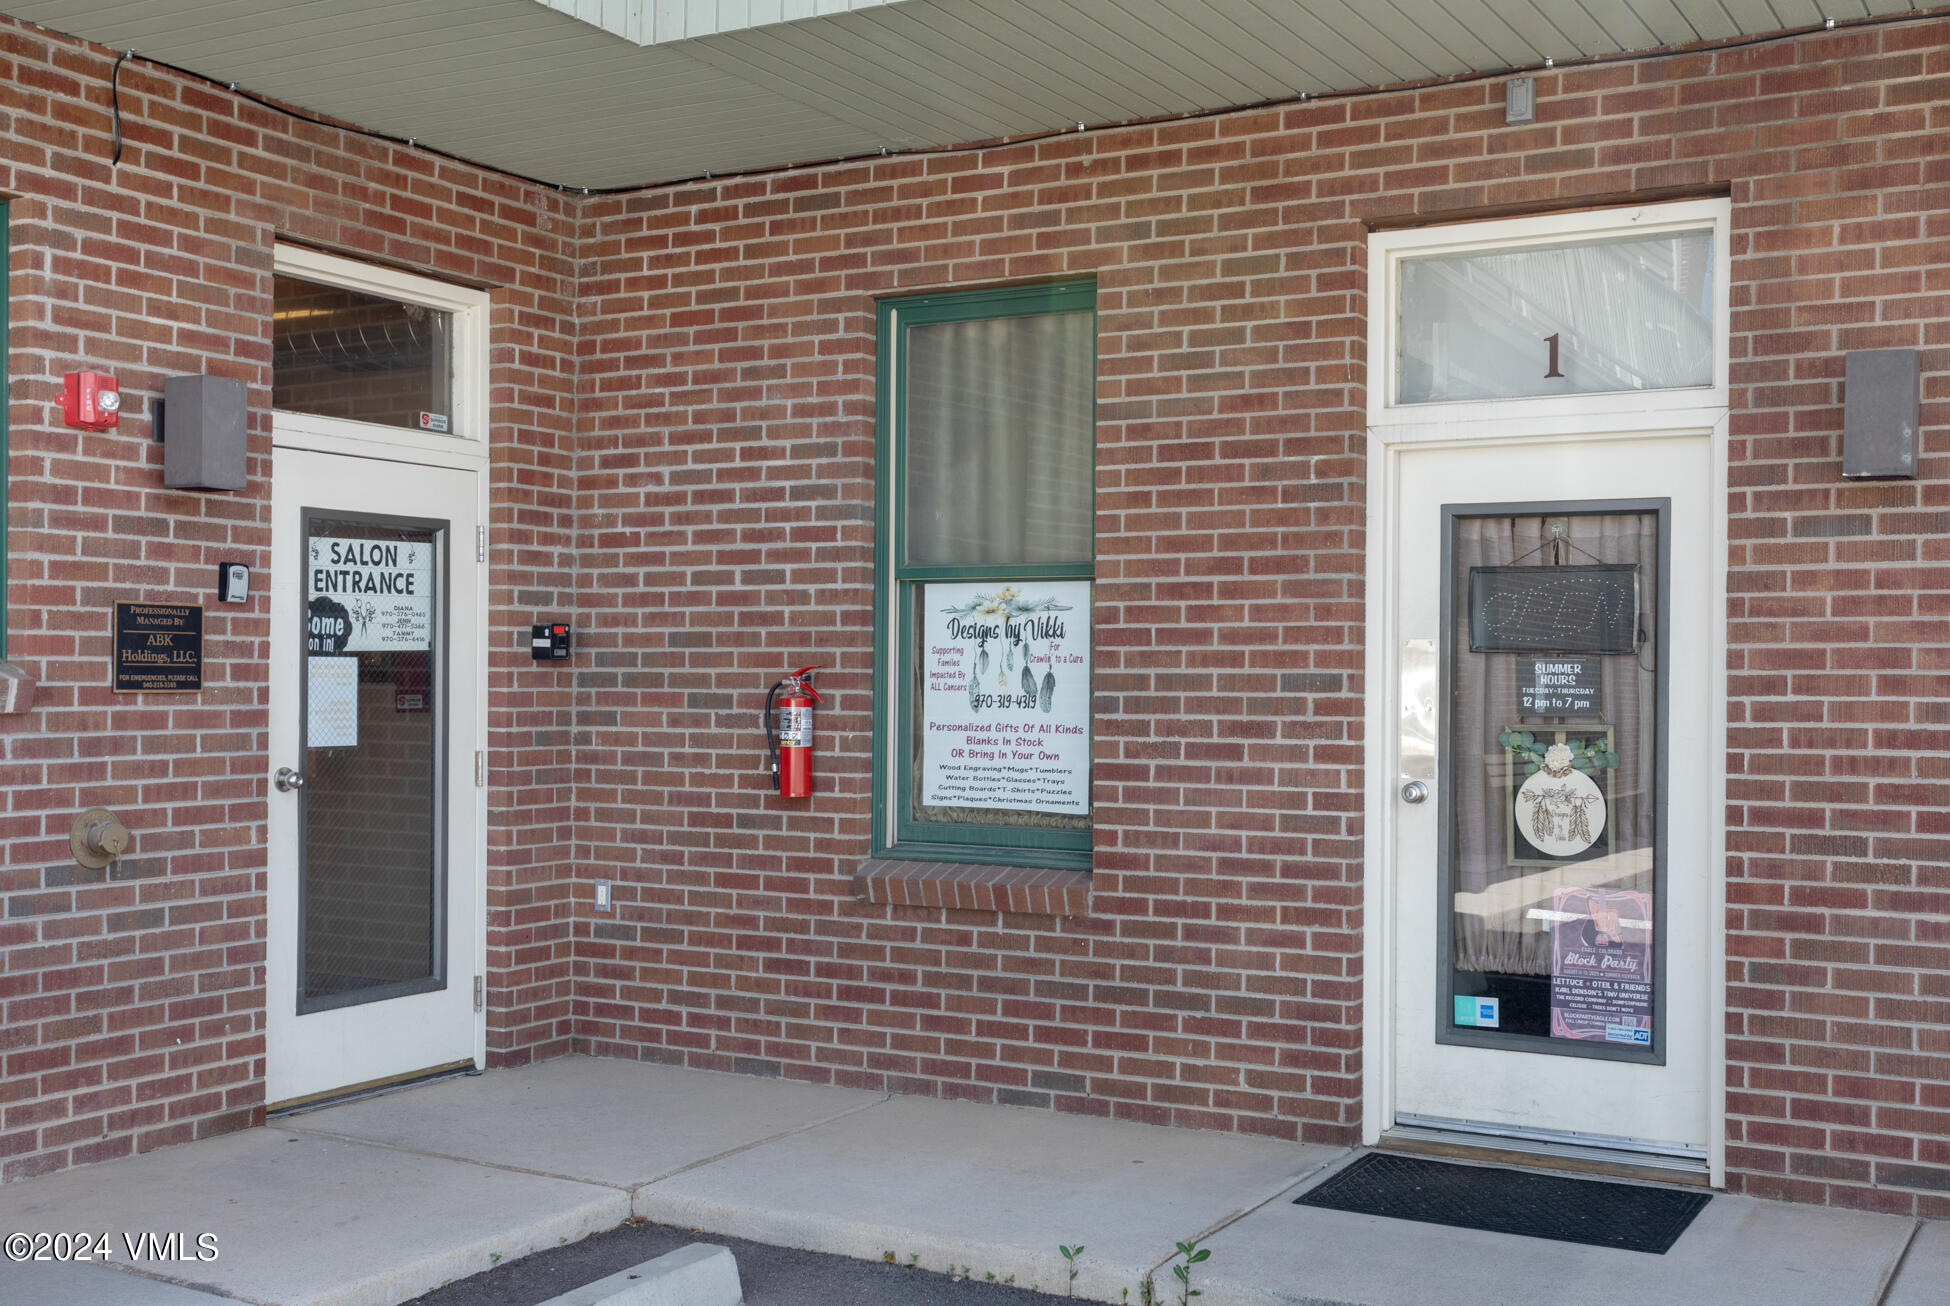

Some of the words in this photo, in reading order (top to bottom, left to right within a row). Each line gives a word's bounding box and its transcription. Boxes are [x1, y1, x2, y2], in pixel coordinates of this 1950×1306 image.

[1543, 332, 1565, 379] 1
[330, 542, 398, 567] SALON
[314, 569, 415, 595] ENTRANCE
[1483, 592, 1625, 629] OPEN
[946, 617, 1000, 648] Designs
[1004, 616, 1023, 647] by
[1024, 615, 1068, 641] Vikki
[146, 633, 174, 646] ABK
[322, 635, 334, 653] in!
[931, 646, 965, 657] Supporting
[1050, 641, 1061, 651] For
[121, 649, 171, 664] Holdings,
[173, 650, 198, 662] LLC.
[1055, 654, 1062, 664] to
[1063, 656, 1068, 664] a
[1068, 654, 1084, 664] Cure
[1535, 663, 1582, 674] SUMMER
[930, 671, 957, 680] Impacted
[957, 671, 966, 680] By
[1540, 674, 1576, 686] HOURS
[930, 682, 942, 691] ALL
[943, 682, 967, 692] Cancers
[1522, 687, 1595, 695] TUESDAY-THURSDAY
[974, 694, 1037, 709] 970-319-4319
[1522, 696, 1533, 707] 12
[1534, 699, 1550, 710] pm
[1552, 698, 1563, 708] to
[1565, 697, 1573, 708] 7
[1574, 699, 1590, 710] pm
[929, 721, 992, 732] Personalized
[995, 722, 1020, 733] Gifts
[1022, 723, 1036, 734] Of
[1038, 724, 1052, 734] All
[1055, 724, 1084, 735] Kinds
[966, 735, 999, 746] Blanks
[1002, 736, 1012, 746] In
[1015, 737, 1045, 747] Stock
[951, 749, 965, 758] OR
[968, 749, 995, 761] Bring
[998, 750, 1007, 759] In
[1011, 750, 1035, 760] Your
[1038, 751, 1060, 761] Own
[939, 763, 961, 771] Wood
[945, 774, 970, 782] Water
[938, 784, 967, 793] Cutting
[1035, 797, 1081, 807] Ornaments
[1564, 951, 1598, 966] Block
[1601, 954, 1639, 973] Party
[1552, 977, 1584, 987] LETTUCE
[1592, 980, 1612, 989] OTEIL
[1613, 982, 1619, 990] &
[1620, 983, 1651, 992] FRIENDS
[1555, 986, 1571, 994] KARL
[1571, 987, 1603, 996] DENSON'S
[1603, 990, 1618, 998] TINY
[1618, 992, 1649, 1001] UNIVERSE
[1634, 1030, 1649, 1042] ADT
